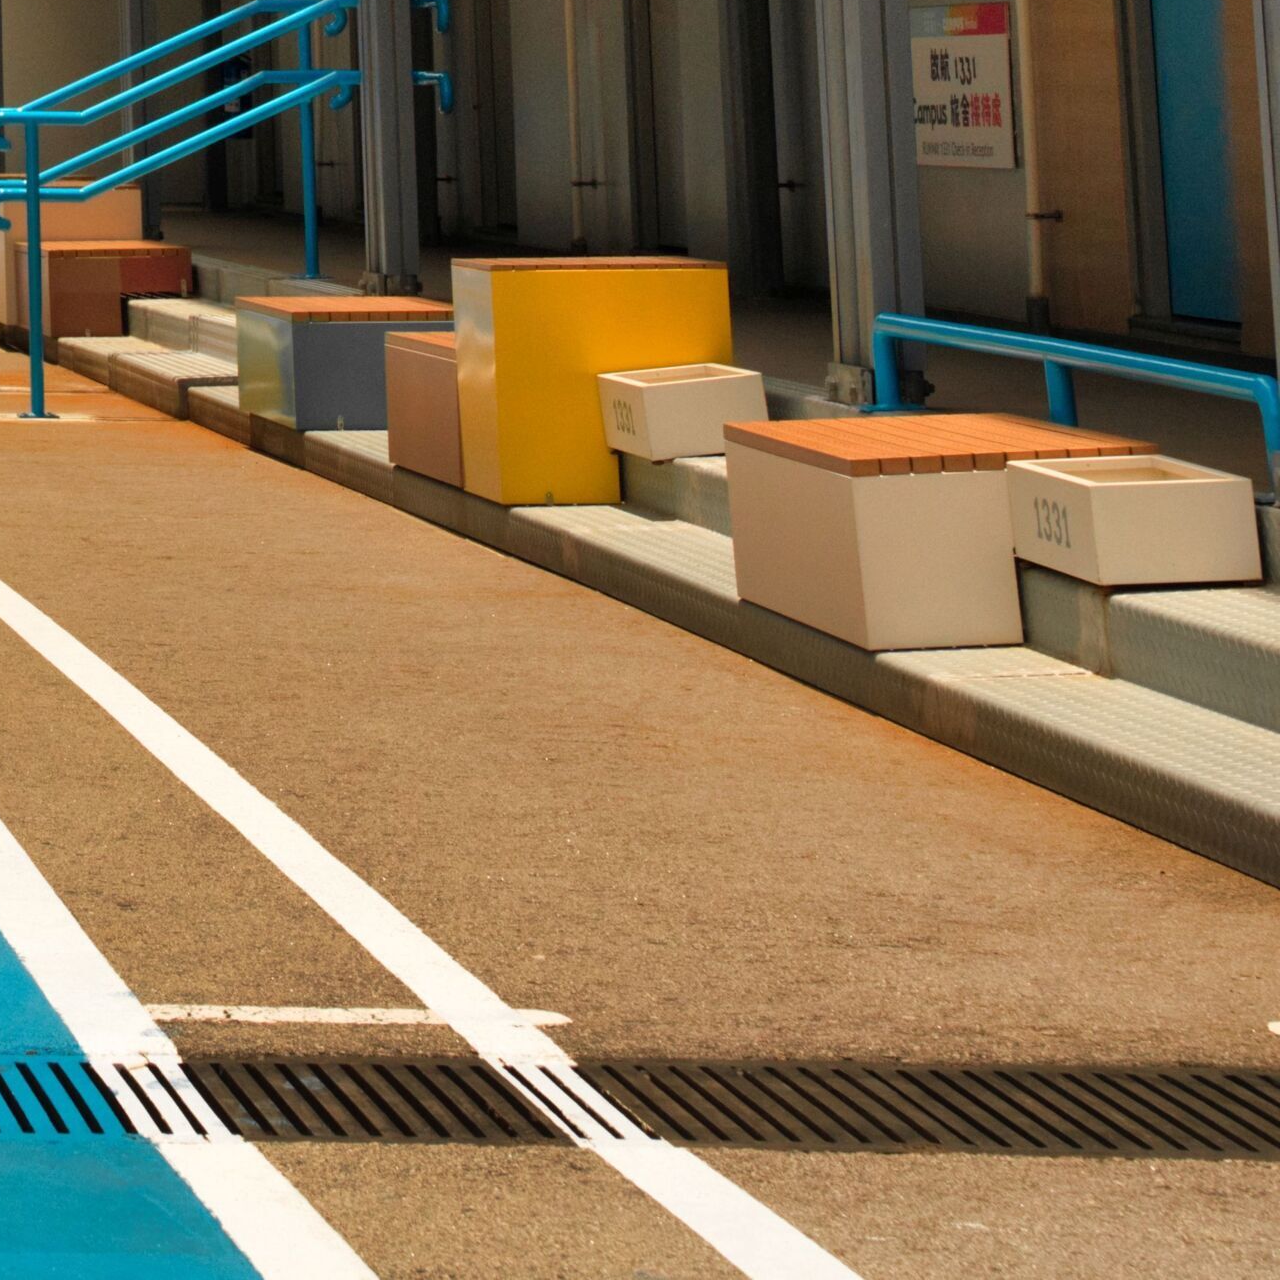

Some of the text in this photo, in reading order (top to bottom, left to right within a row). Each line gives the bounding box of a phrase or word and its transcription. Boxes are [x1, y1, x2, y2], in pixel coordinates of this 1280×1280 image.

[954, 56, 977, 85] 1331
[612, 398, 636, 436] 1331
[1034, 496, 1071, 549] 1331
